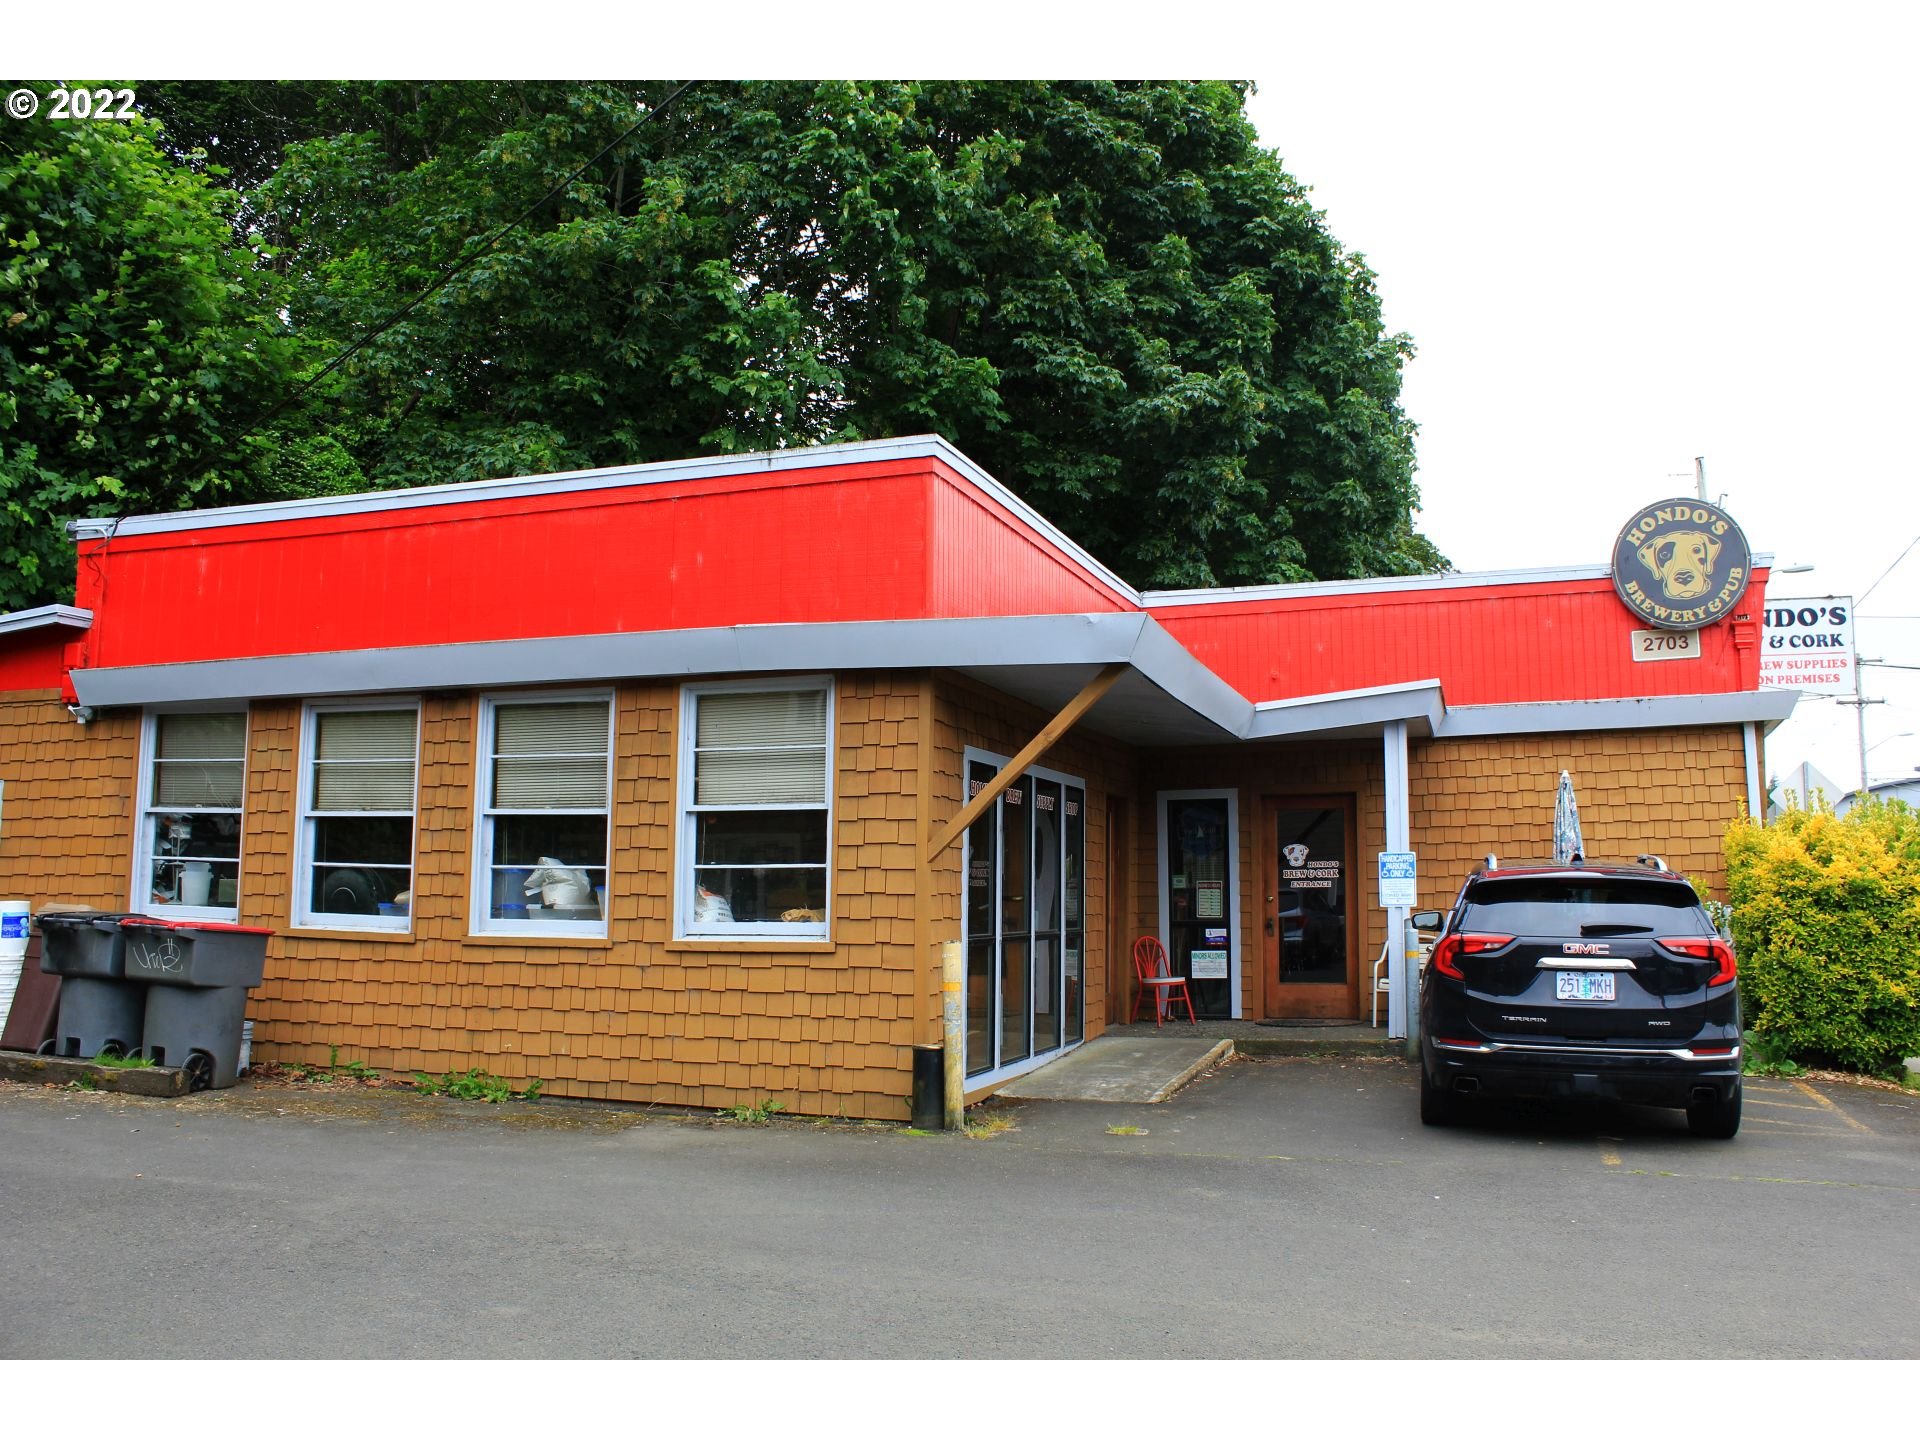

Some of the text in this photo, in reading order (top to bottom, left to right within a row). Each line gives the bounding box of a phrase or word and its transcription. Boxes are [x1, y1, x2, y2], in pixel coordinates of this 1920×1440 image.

[1626, 506, 1729, 547] HONDO'S
[1625, 567, 1743, 622] BREWERY & PUB
[1643, 635, 1689, 651] 2703
[1769, 633, 1844, 648] & CORK
[1786, 659, 1847, 669] SUPPLIES
[1778, 673, 1841, 684] PREMISES
[1385, 862, 1409, 870] PARKING
[1283, 869, 1339, 878] BREW & CORK
[1563, 943, 1609, 954] GMC
[1560, 978, 1612, 993] 251 MKH
[1502, 1015, 1547, 1023] TERRAIN
